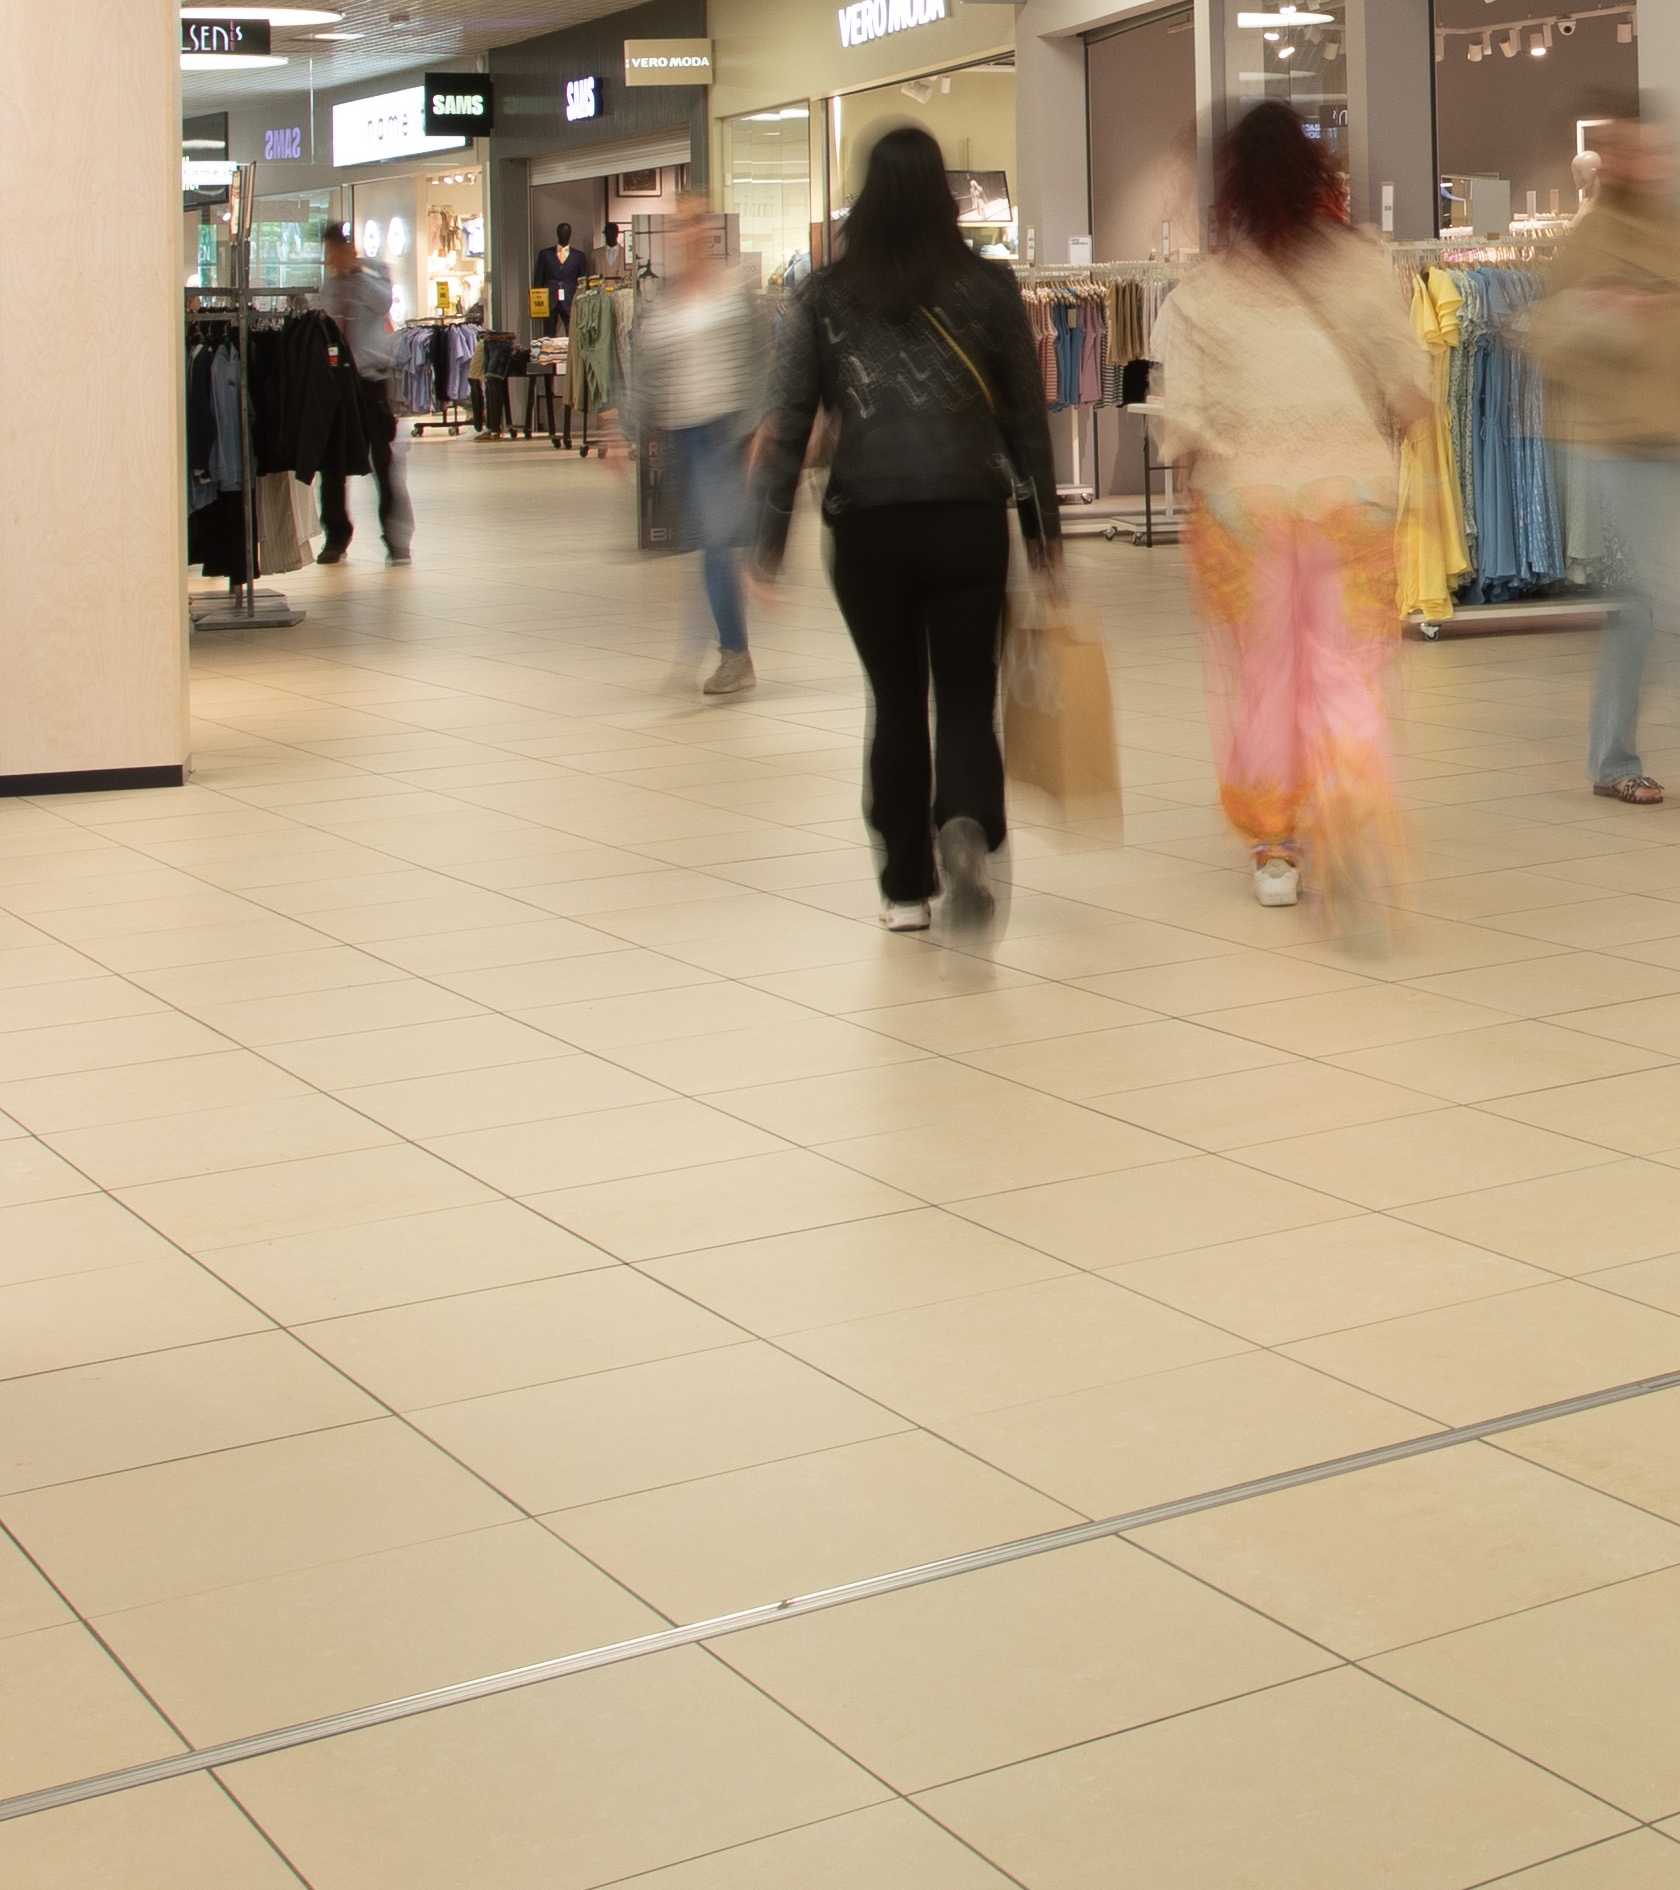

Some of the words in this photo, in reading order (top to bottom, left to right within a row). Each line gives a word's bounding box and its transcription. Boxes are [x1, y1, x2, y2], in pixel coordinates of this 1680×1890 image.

[631, 57, 667, 68] VERO
[669, 56, 709, 68] MODA
[432, 94, 483, 115] SAMS
[567, 76, 595, 122] SAMS
